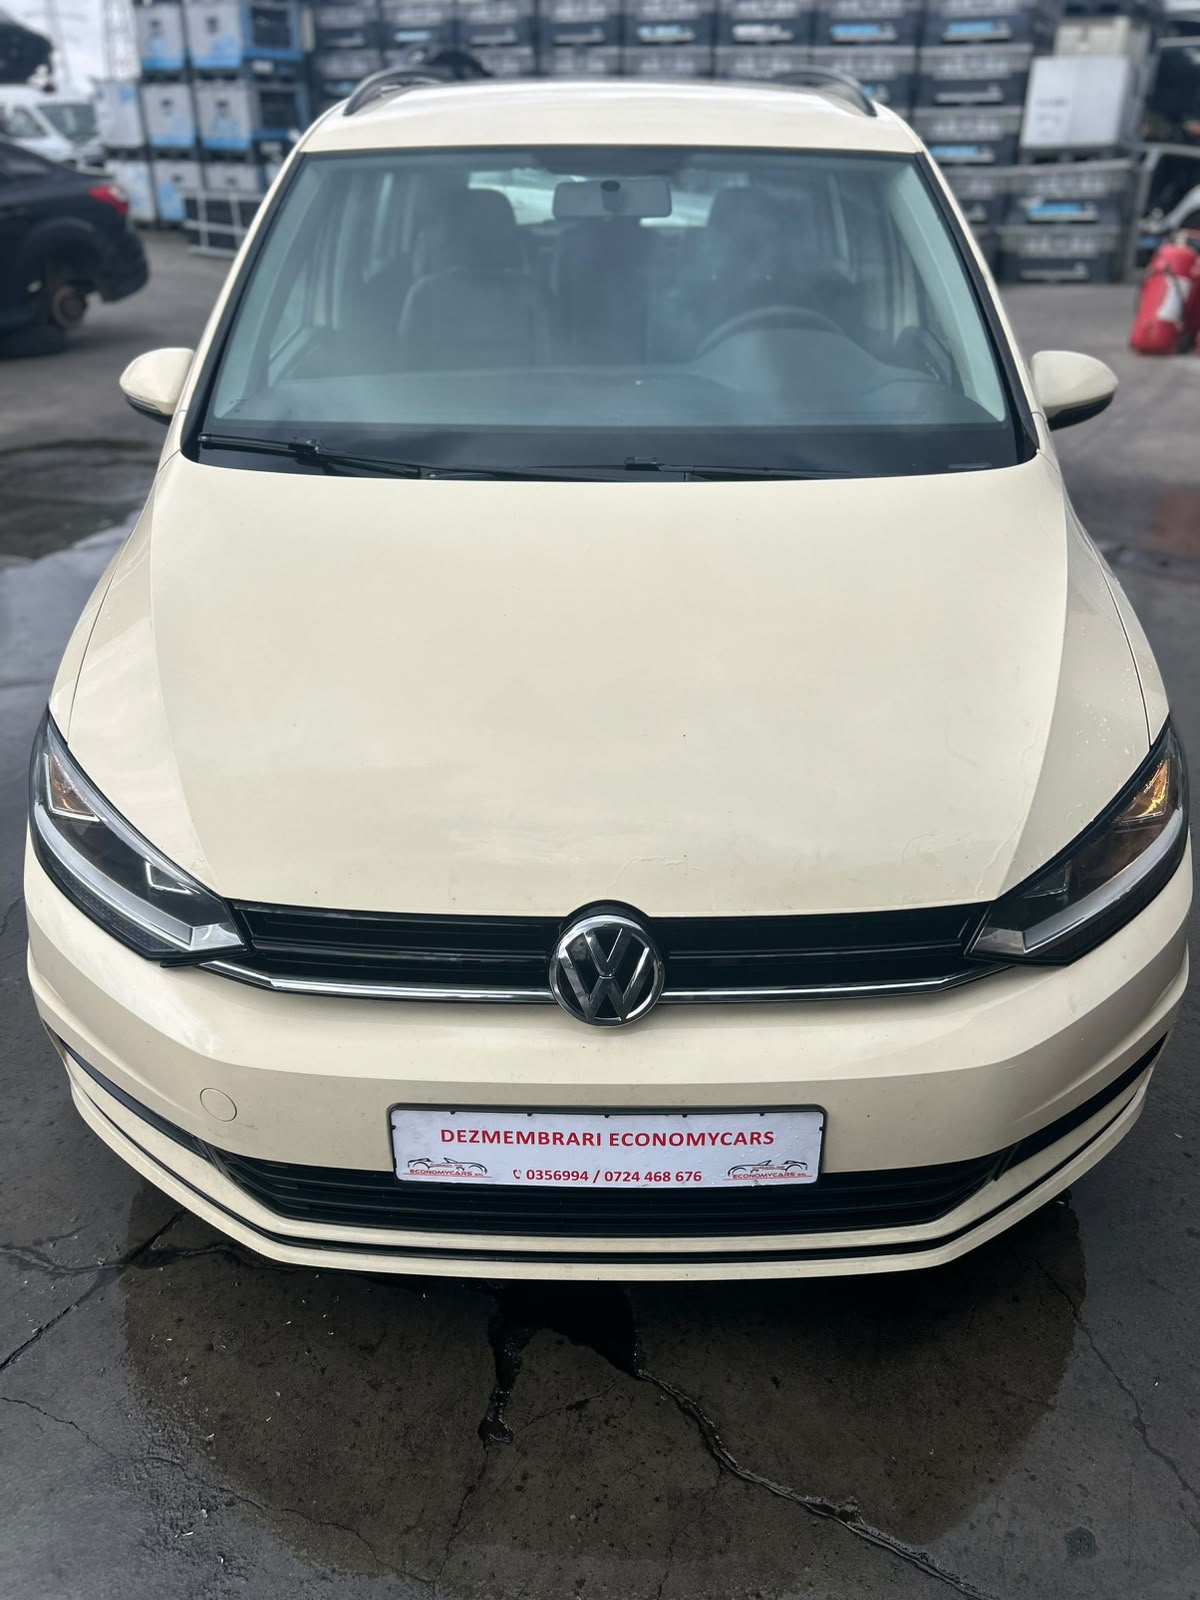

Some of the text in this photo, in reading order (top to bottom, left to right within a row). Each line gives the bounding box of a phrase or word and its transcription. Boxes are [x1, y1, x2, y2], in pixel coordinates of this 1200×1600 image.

[441, 1129, 774, 1146] DEZMEMBRARI ECONOMYCARS
[409, 1169, 473, 1177] ECONOMYCARS
[526, 1169, 702, 1184] 0356994 / 0724 468 676
[732, 1171, 795, 1180] ECONOMYCARS
